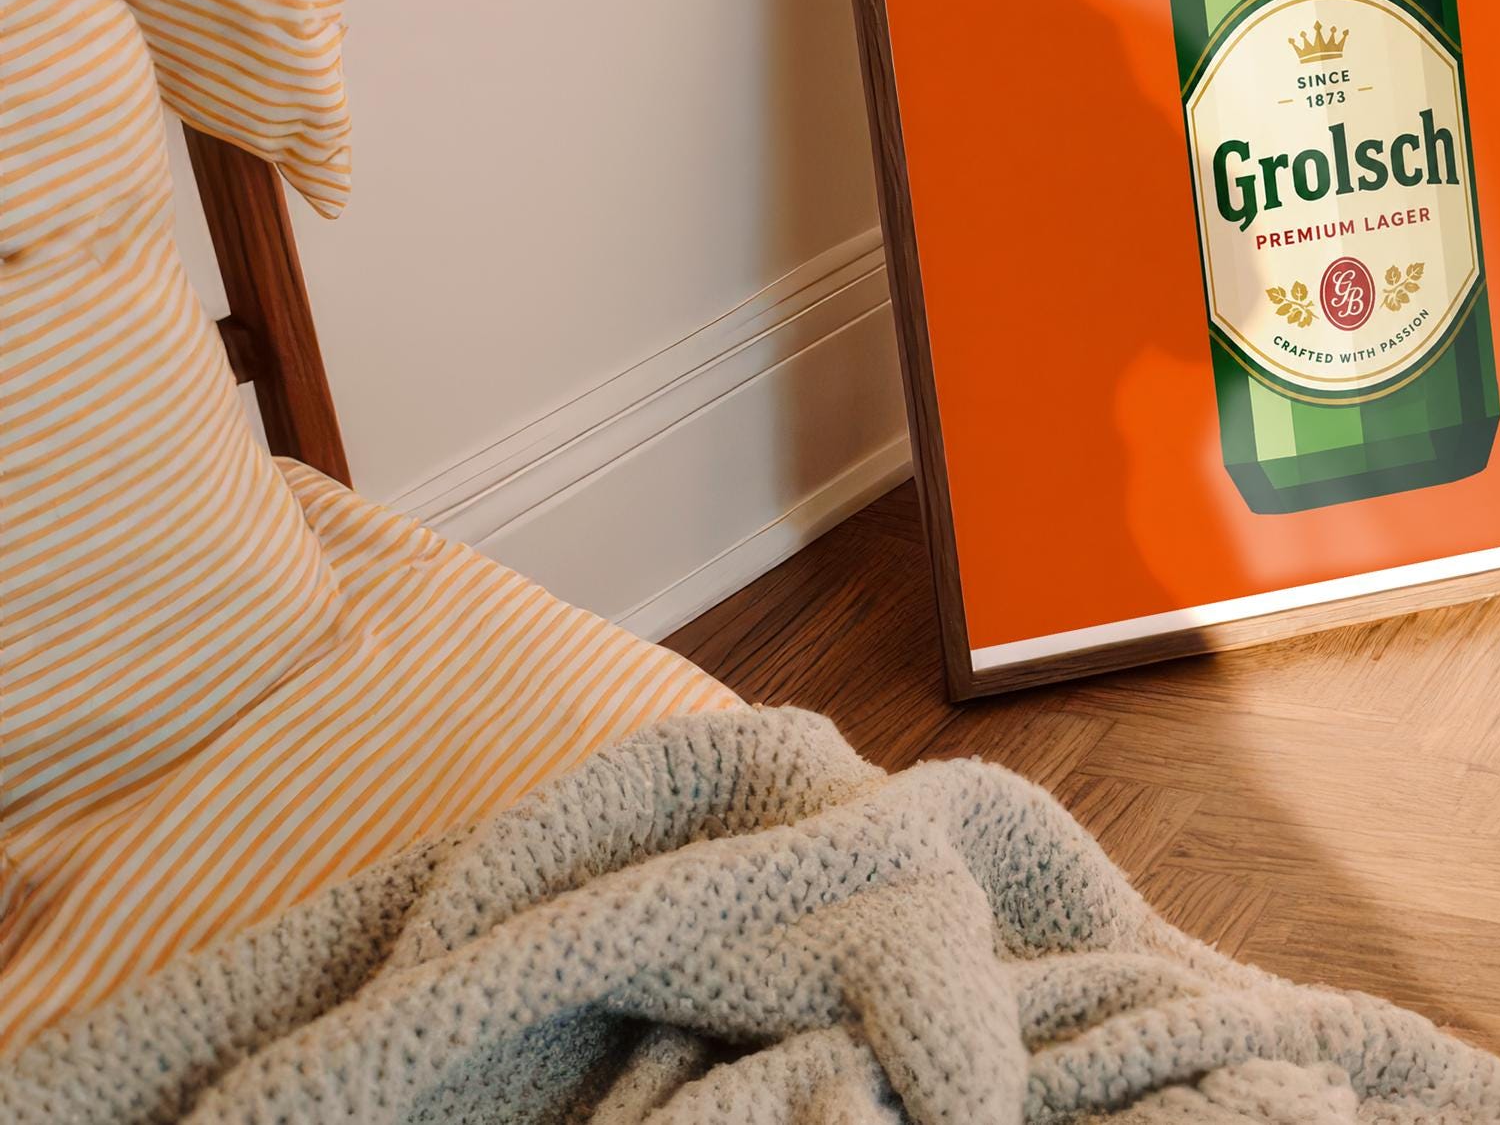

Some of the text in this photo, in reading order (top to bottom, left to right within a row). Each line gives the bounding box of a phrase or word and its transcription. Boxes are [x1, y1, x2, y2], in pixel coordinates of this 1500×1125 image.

[1297, 69, 1351, 89] SINCE
[1306, 90, 1346, 108] 1873
[1212, 108, 1460, 233] Grolsch
[1255, 207, 1431, 250] PREMIUM LAGER
[1273, 308, 1430, 364] CRAFTED WITH PASSION
